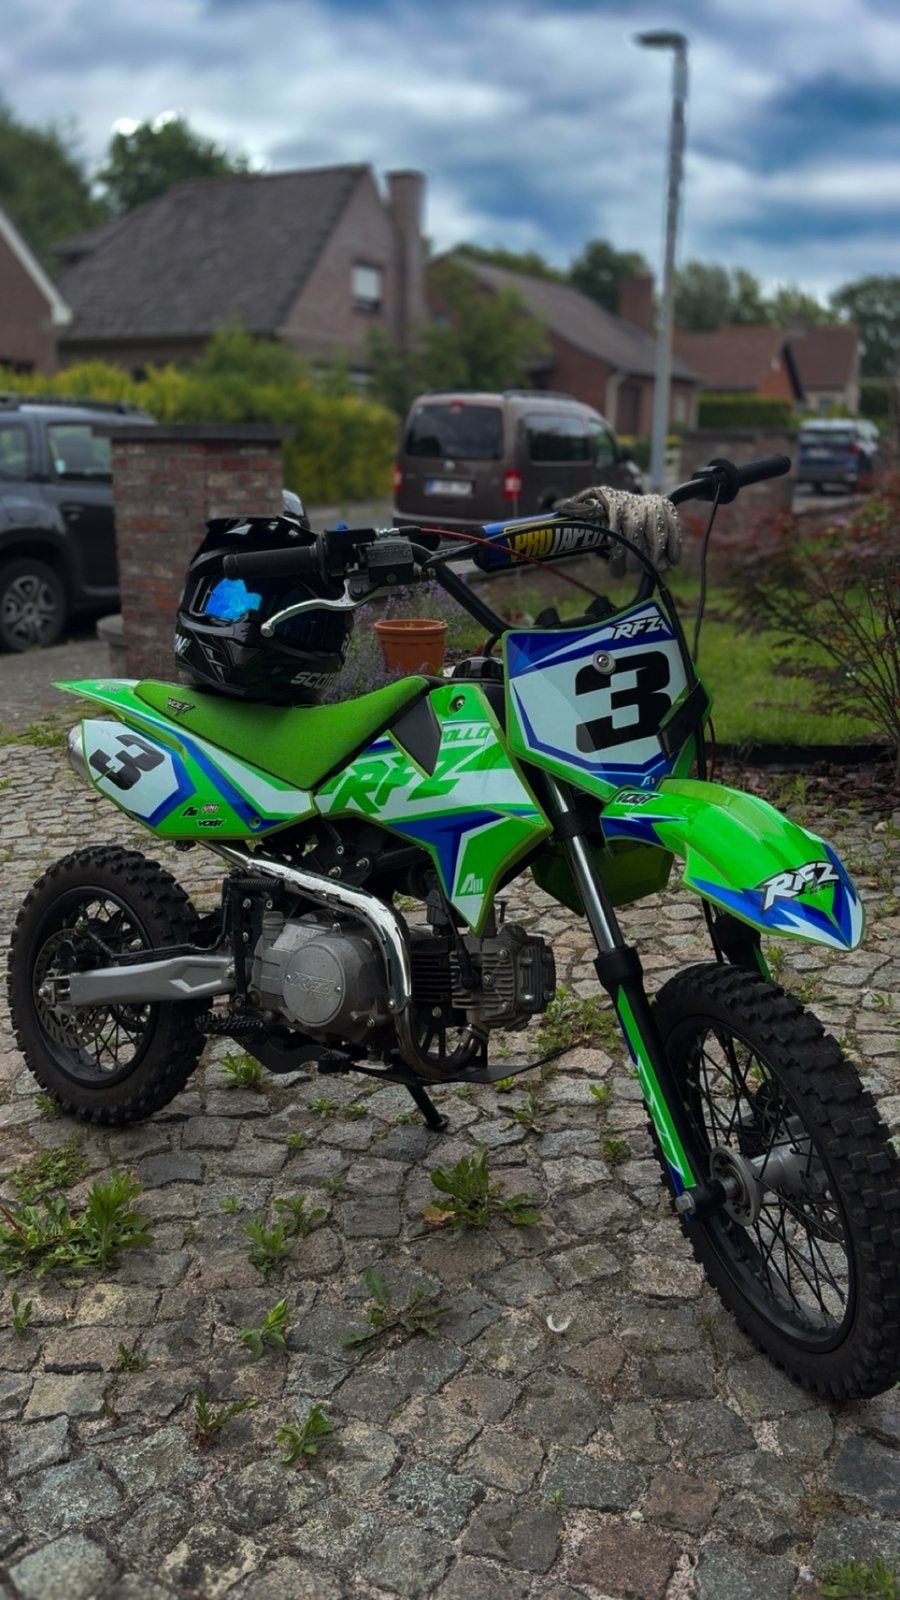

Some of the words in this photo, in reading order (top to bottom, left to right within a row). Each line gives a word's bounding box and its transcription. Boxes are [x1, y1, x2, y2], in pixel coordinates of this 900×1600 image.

[612, 616, 664, 640] RFZ
[575, 651, 672, 753] 3
[88, 734, 165, 791] 3
[762, 861, 840, 912] RFZ
